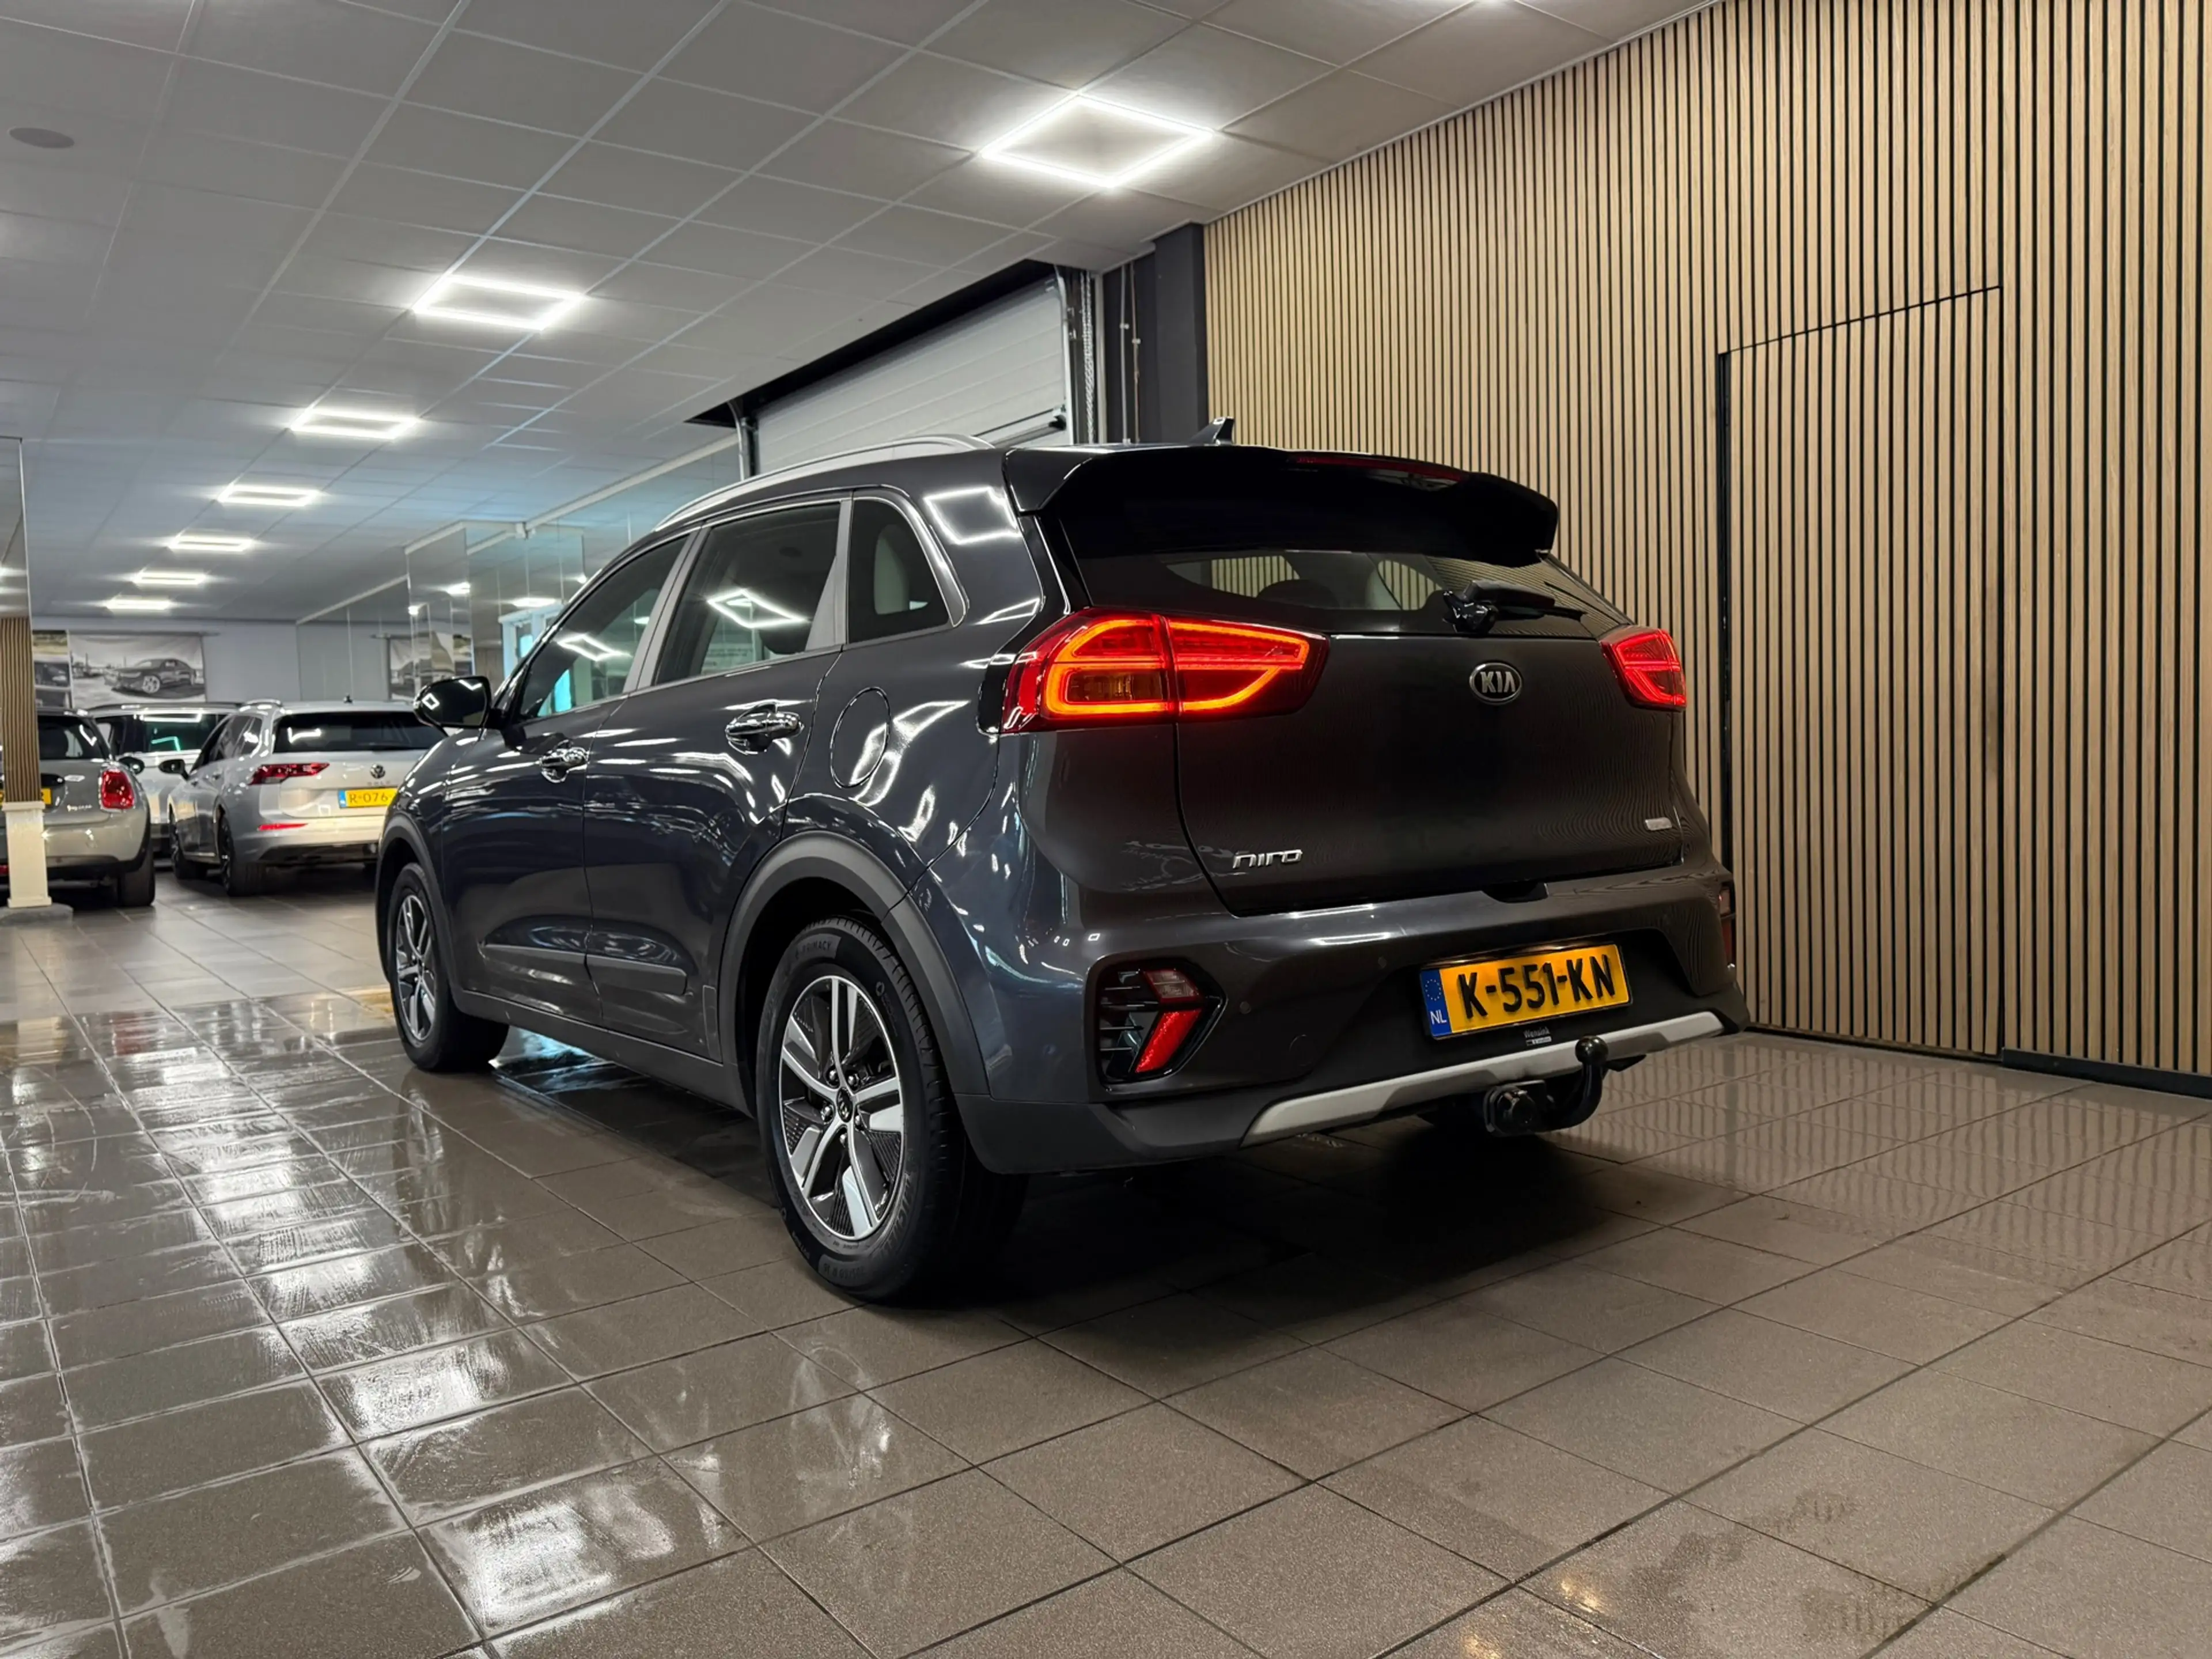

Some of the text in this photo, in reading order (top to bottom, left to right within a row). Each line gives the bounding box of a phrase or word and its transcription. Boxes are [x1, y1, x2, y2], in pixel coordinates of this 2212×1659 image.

[1480, 671, 1516, 693] KIA
[1457, 954, 1615, 1019] K-551-KN
[1430, 1010, 1447, 1025] NL
